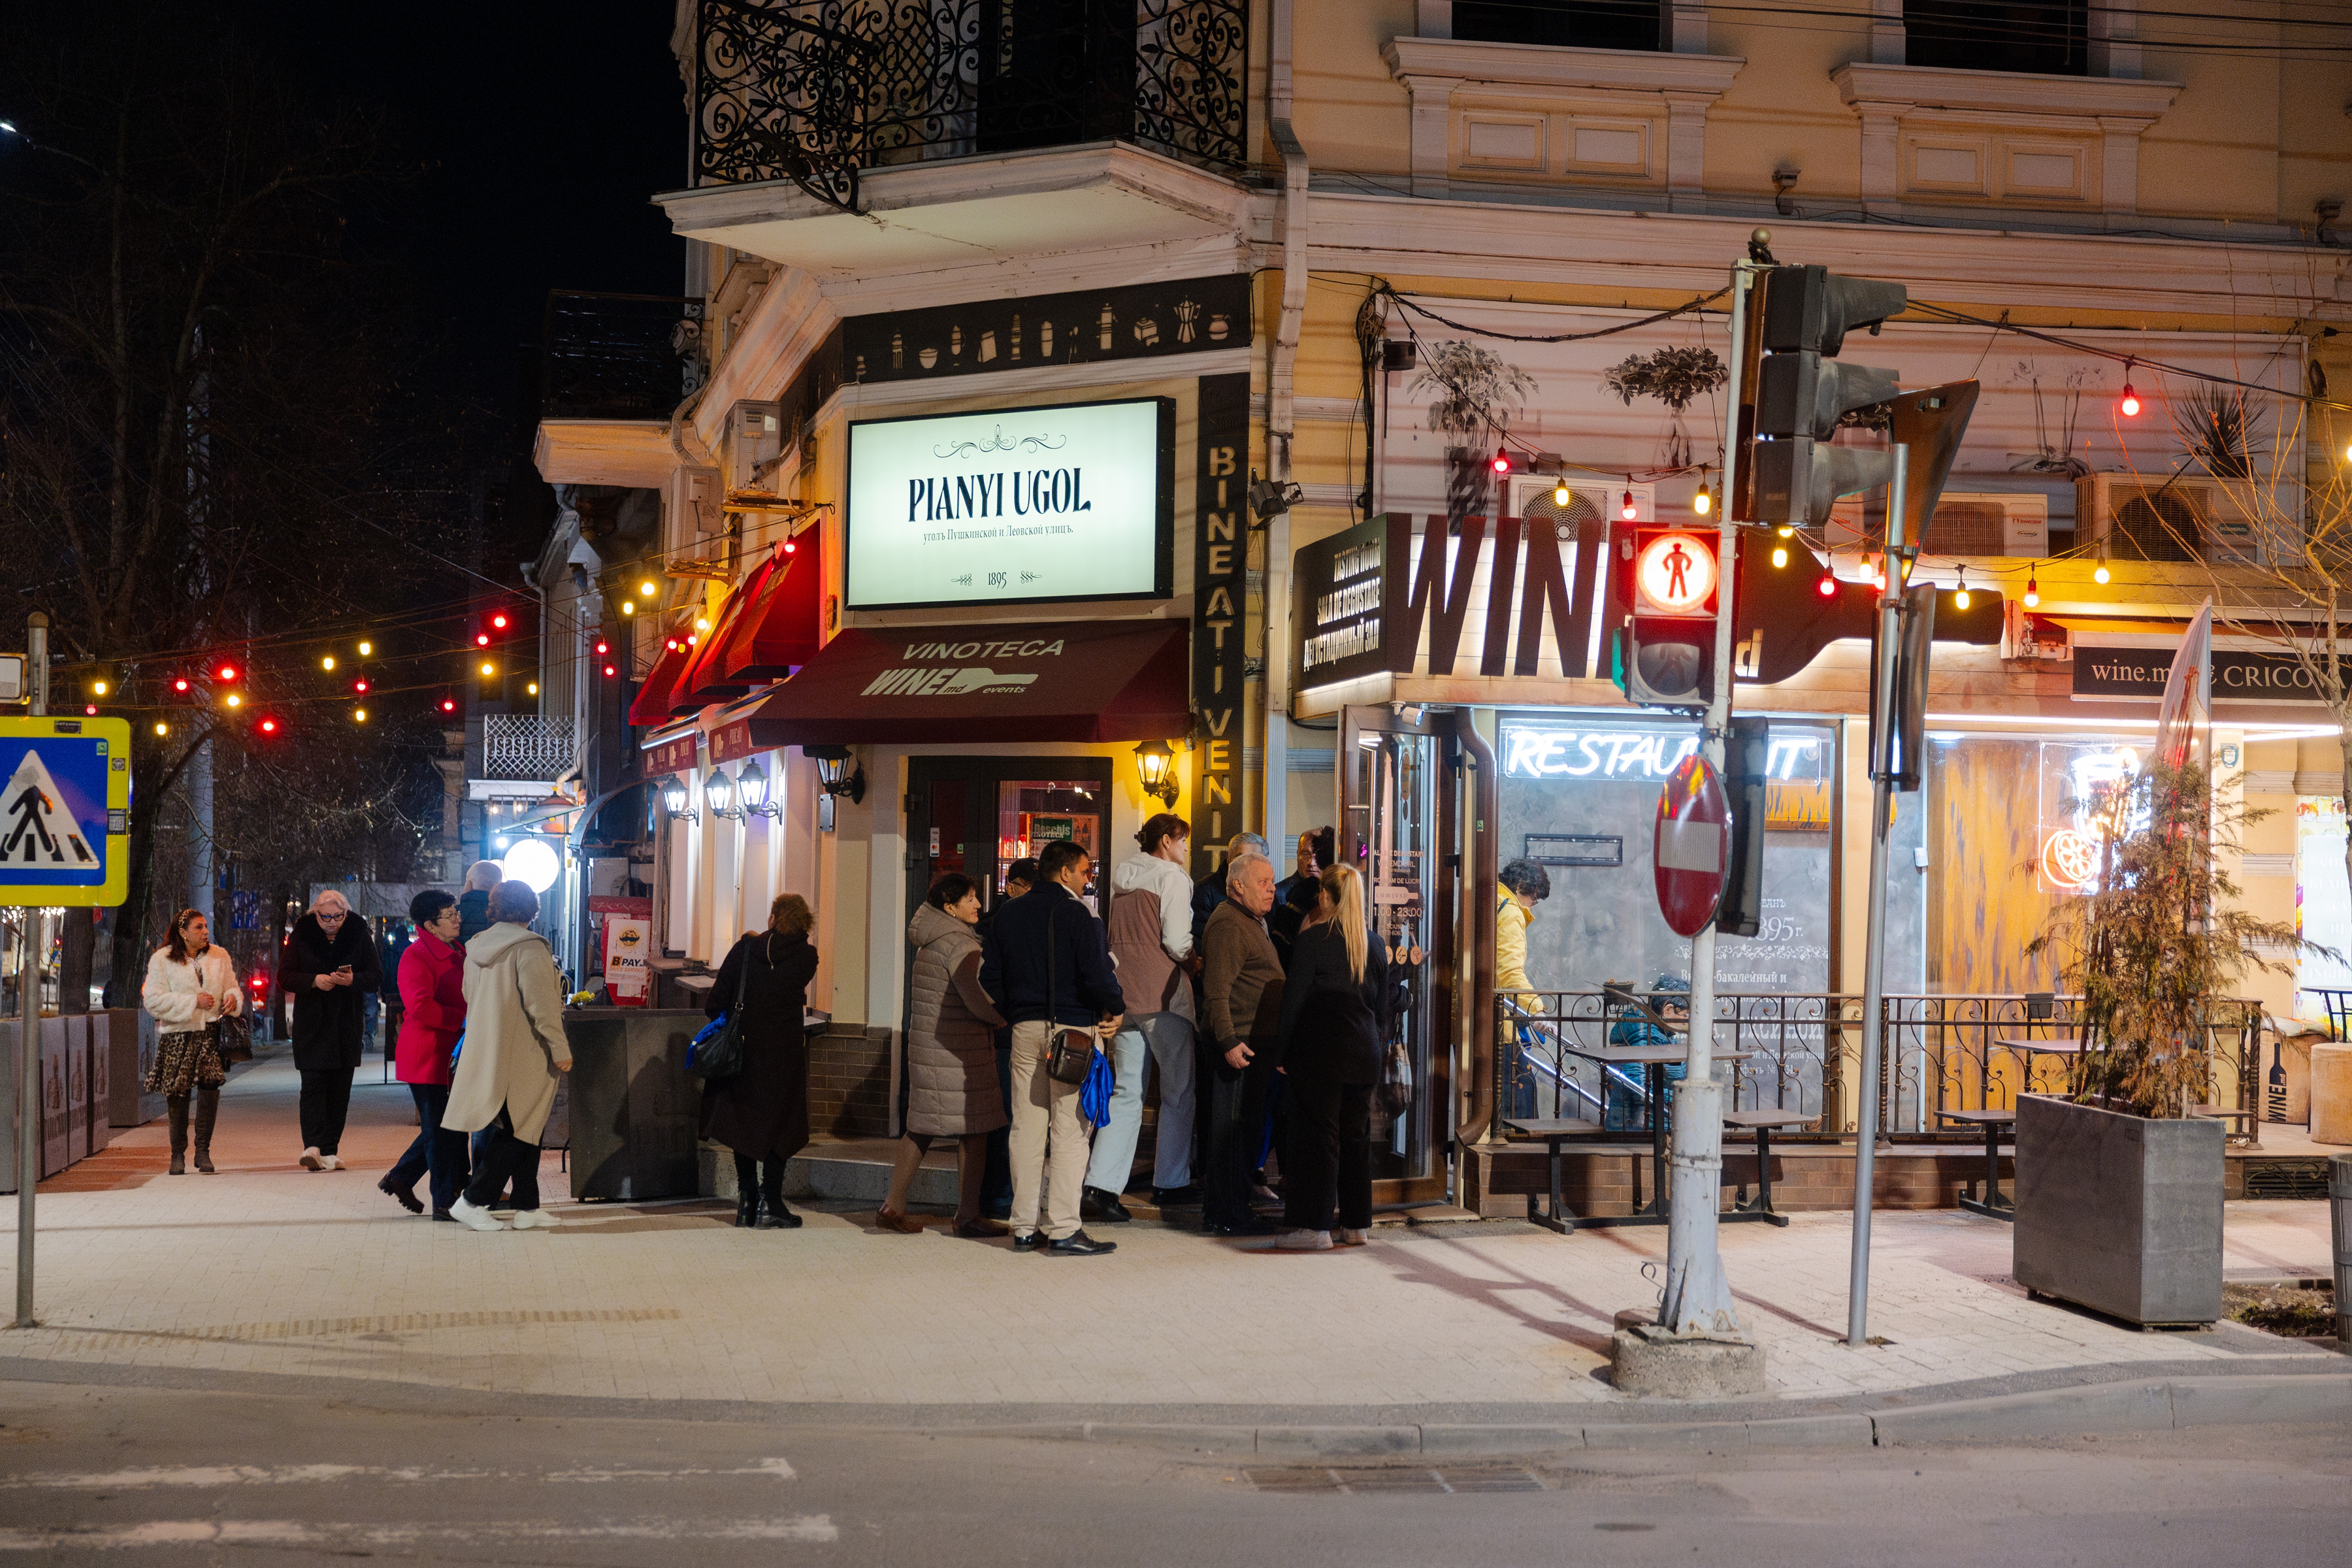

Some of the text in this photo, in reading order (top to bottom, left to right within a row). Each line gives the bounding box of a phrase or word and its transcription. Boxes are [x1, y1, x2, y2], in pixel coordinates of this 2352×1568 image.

[909, 468, 1091, 522] PIANYI UGOL
[1207, 446, 1235, 574] BINE
[923, 532, 945, 545] уголъ
[947, 527, 997, 542] Пушкинской
[999, 529, 1004, 538] и
[1006, 525, 1043, 537] Леовской
[988, 572, 1007, 589] 1895
[1334, 546, 1359, 582] TASTING
[1317, 577, 1380, 626] SALA DE DEGUSTARE
[903, 640, 1064, 660] VINOTECA
[1303, 617, 1380, 672] ДЕГУСТАЦИОННЫЙ ЗАЛ
[860, 668, 958, 696] WINE
[983, 685, 1026, 694] events
[2091, 659, 2169, 682] wine.m
[1507, 730, 1819, 781] RESTAUT
[1202, 707, 1232, 872] VENIT
[1761, 898, 1786, 909] ВАНЪ
[1747, 917, 1795, 941] 895
[2268, 1086, 2287, 1122] WINE
